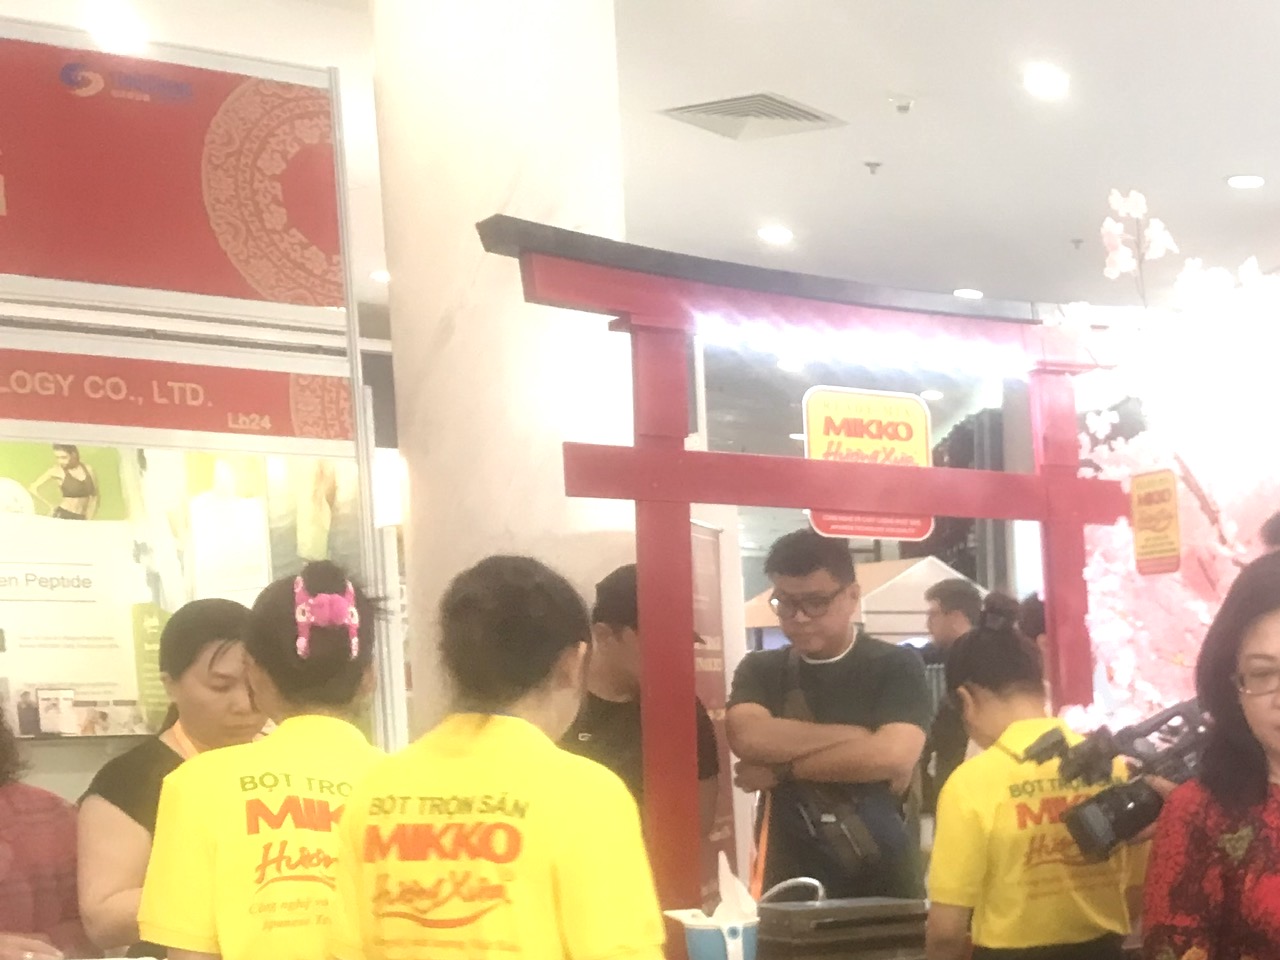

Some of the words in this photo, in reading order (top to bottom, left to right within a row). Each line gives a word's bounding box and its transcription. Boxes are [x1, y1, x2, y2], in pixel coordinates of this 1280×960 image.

[84, 376, 143, 406] CO.,
[153, 381, 213, 408] LTD.
[823, 416, 913, 441] MIKKO
[25, 573, 92, 591] Peptide
[246, 795, 346, 835] MIK
[364, 822, 523, 863] MIKKO
